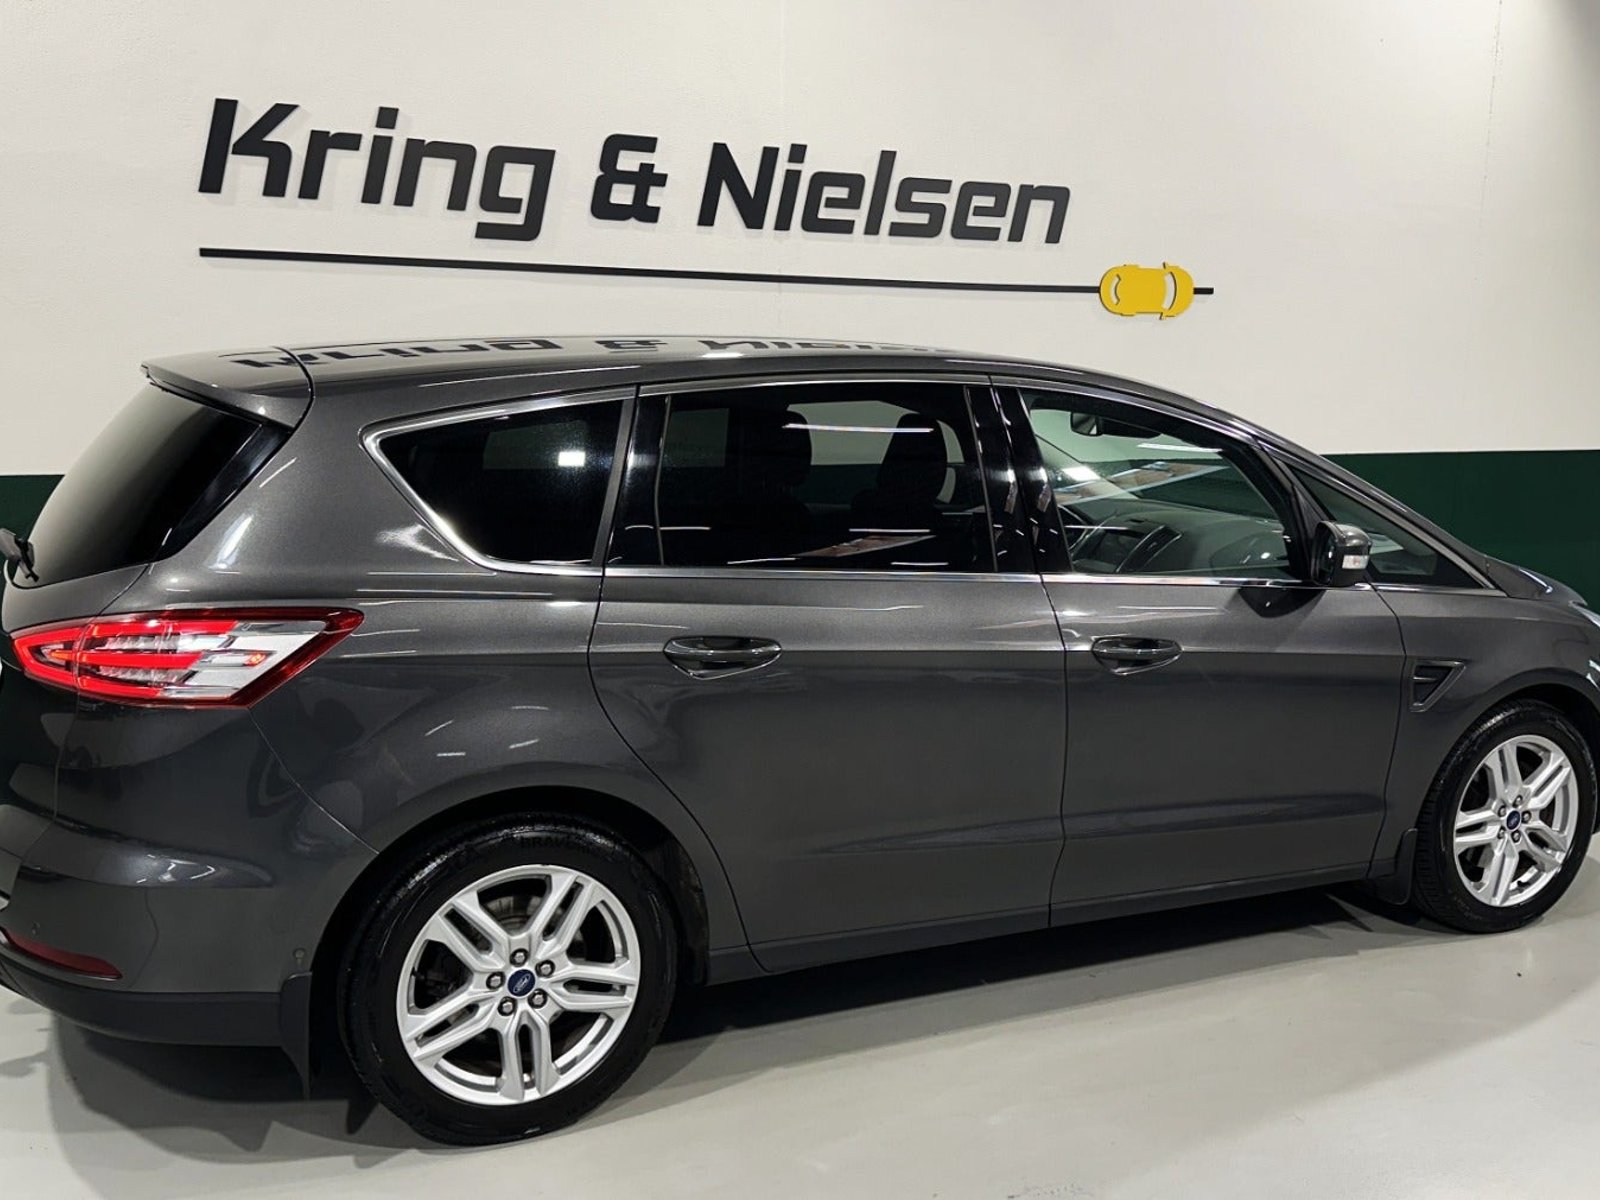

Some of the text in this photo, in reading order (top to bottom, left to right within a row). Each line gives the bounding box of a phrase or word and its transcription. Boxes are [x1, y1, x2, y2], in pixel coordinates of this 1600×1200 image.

[197, 97, 1071, 244] Kring & Nielsen
